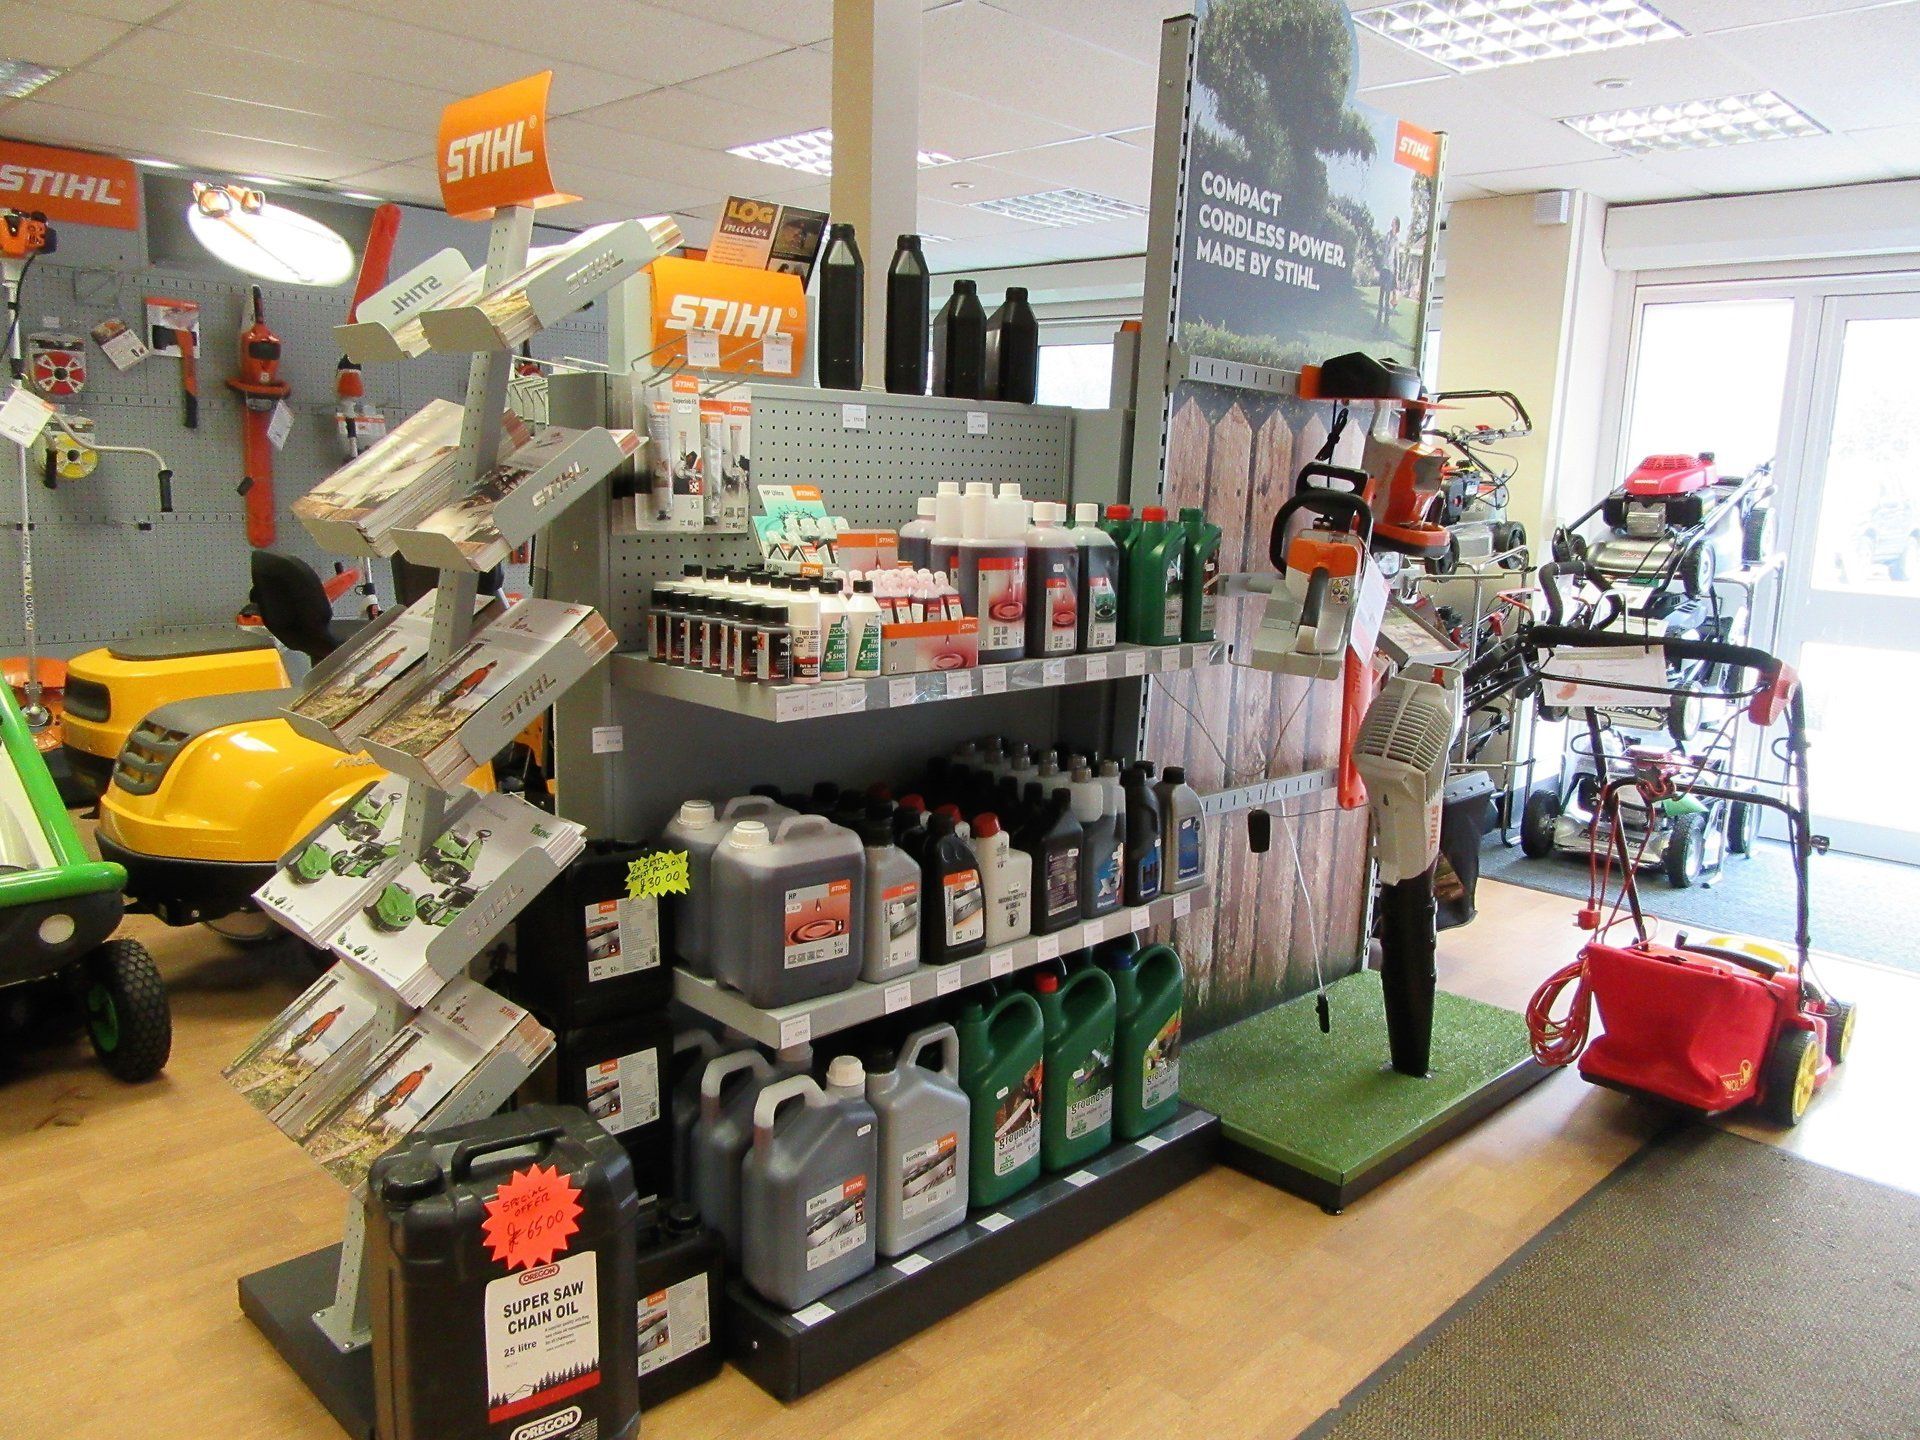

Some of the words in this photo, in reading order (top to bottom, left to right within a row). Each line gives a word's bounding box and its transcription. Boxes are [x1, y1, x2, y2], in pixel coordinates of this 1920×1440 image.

[446, 120, 535, 183] STIHL
[1399, 135, 1432, 162] STIHL
[0, 164, 122, 206] STIHL
[1201, 170, 1282, 217] COMPACT
[727, 200, 775, 225] LOG
[723, 224, 769, 238] master
[1199, 204, 1285, 250] CORDLESS
[1289, 231, 1346, 268] POWER.
[565, 249, 625, 296] STIHL
[1196, 236, 1245, 272] MADE
[1249, 251, 1273, 278] BY
[1274, 259, 1320, 291] STIHL.
[664, 294, 787, 339] STIHL
[674, 381, 697, 389] STIHL
[801, 566, 821, 575] STIHL
[960, 622, 977, 630] STIHL
[499, 673, 557, 729] STIHL
[788, 892, 797, 900] HP
[830, 884, 848, 892] STIHL
[498, 1005, 519, 1021] STIHL
[938, 1136, 955, 1148] STIHL
[844, 1180, 863, 1194] STIHL
[514, 1192, 550, 1217] OFFER
[523, 1266, 556, 1282] OREGON
[503, 1292, 550, 1319] SUPER
[553, 1280, 584, 1301] SAW
[507, 1308, 552, 1335] CHAIN
[556, 1301, 579, 1318] OIL
[504, 1348, 516, 1358] 25
[518, 1340, 537, 1353] litre
[518, 1412, 574, 1440] OREGON
